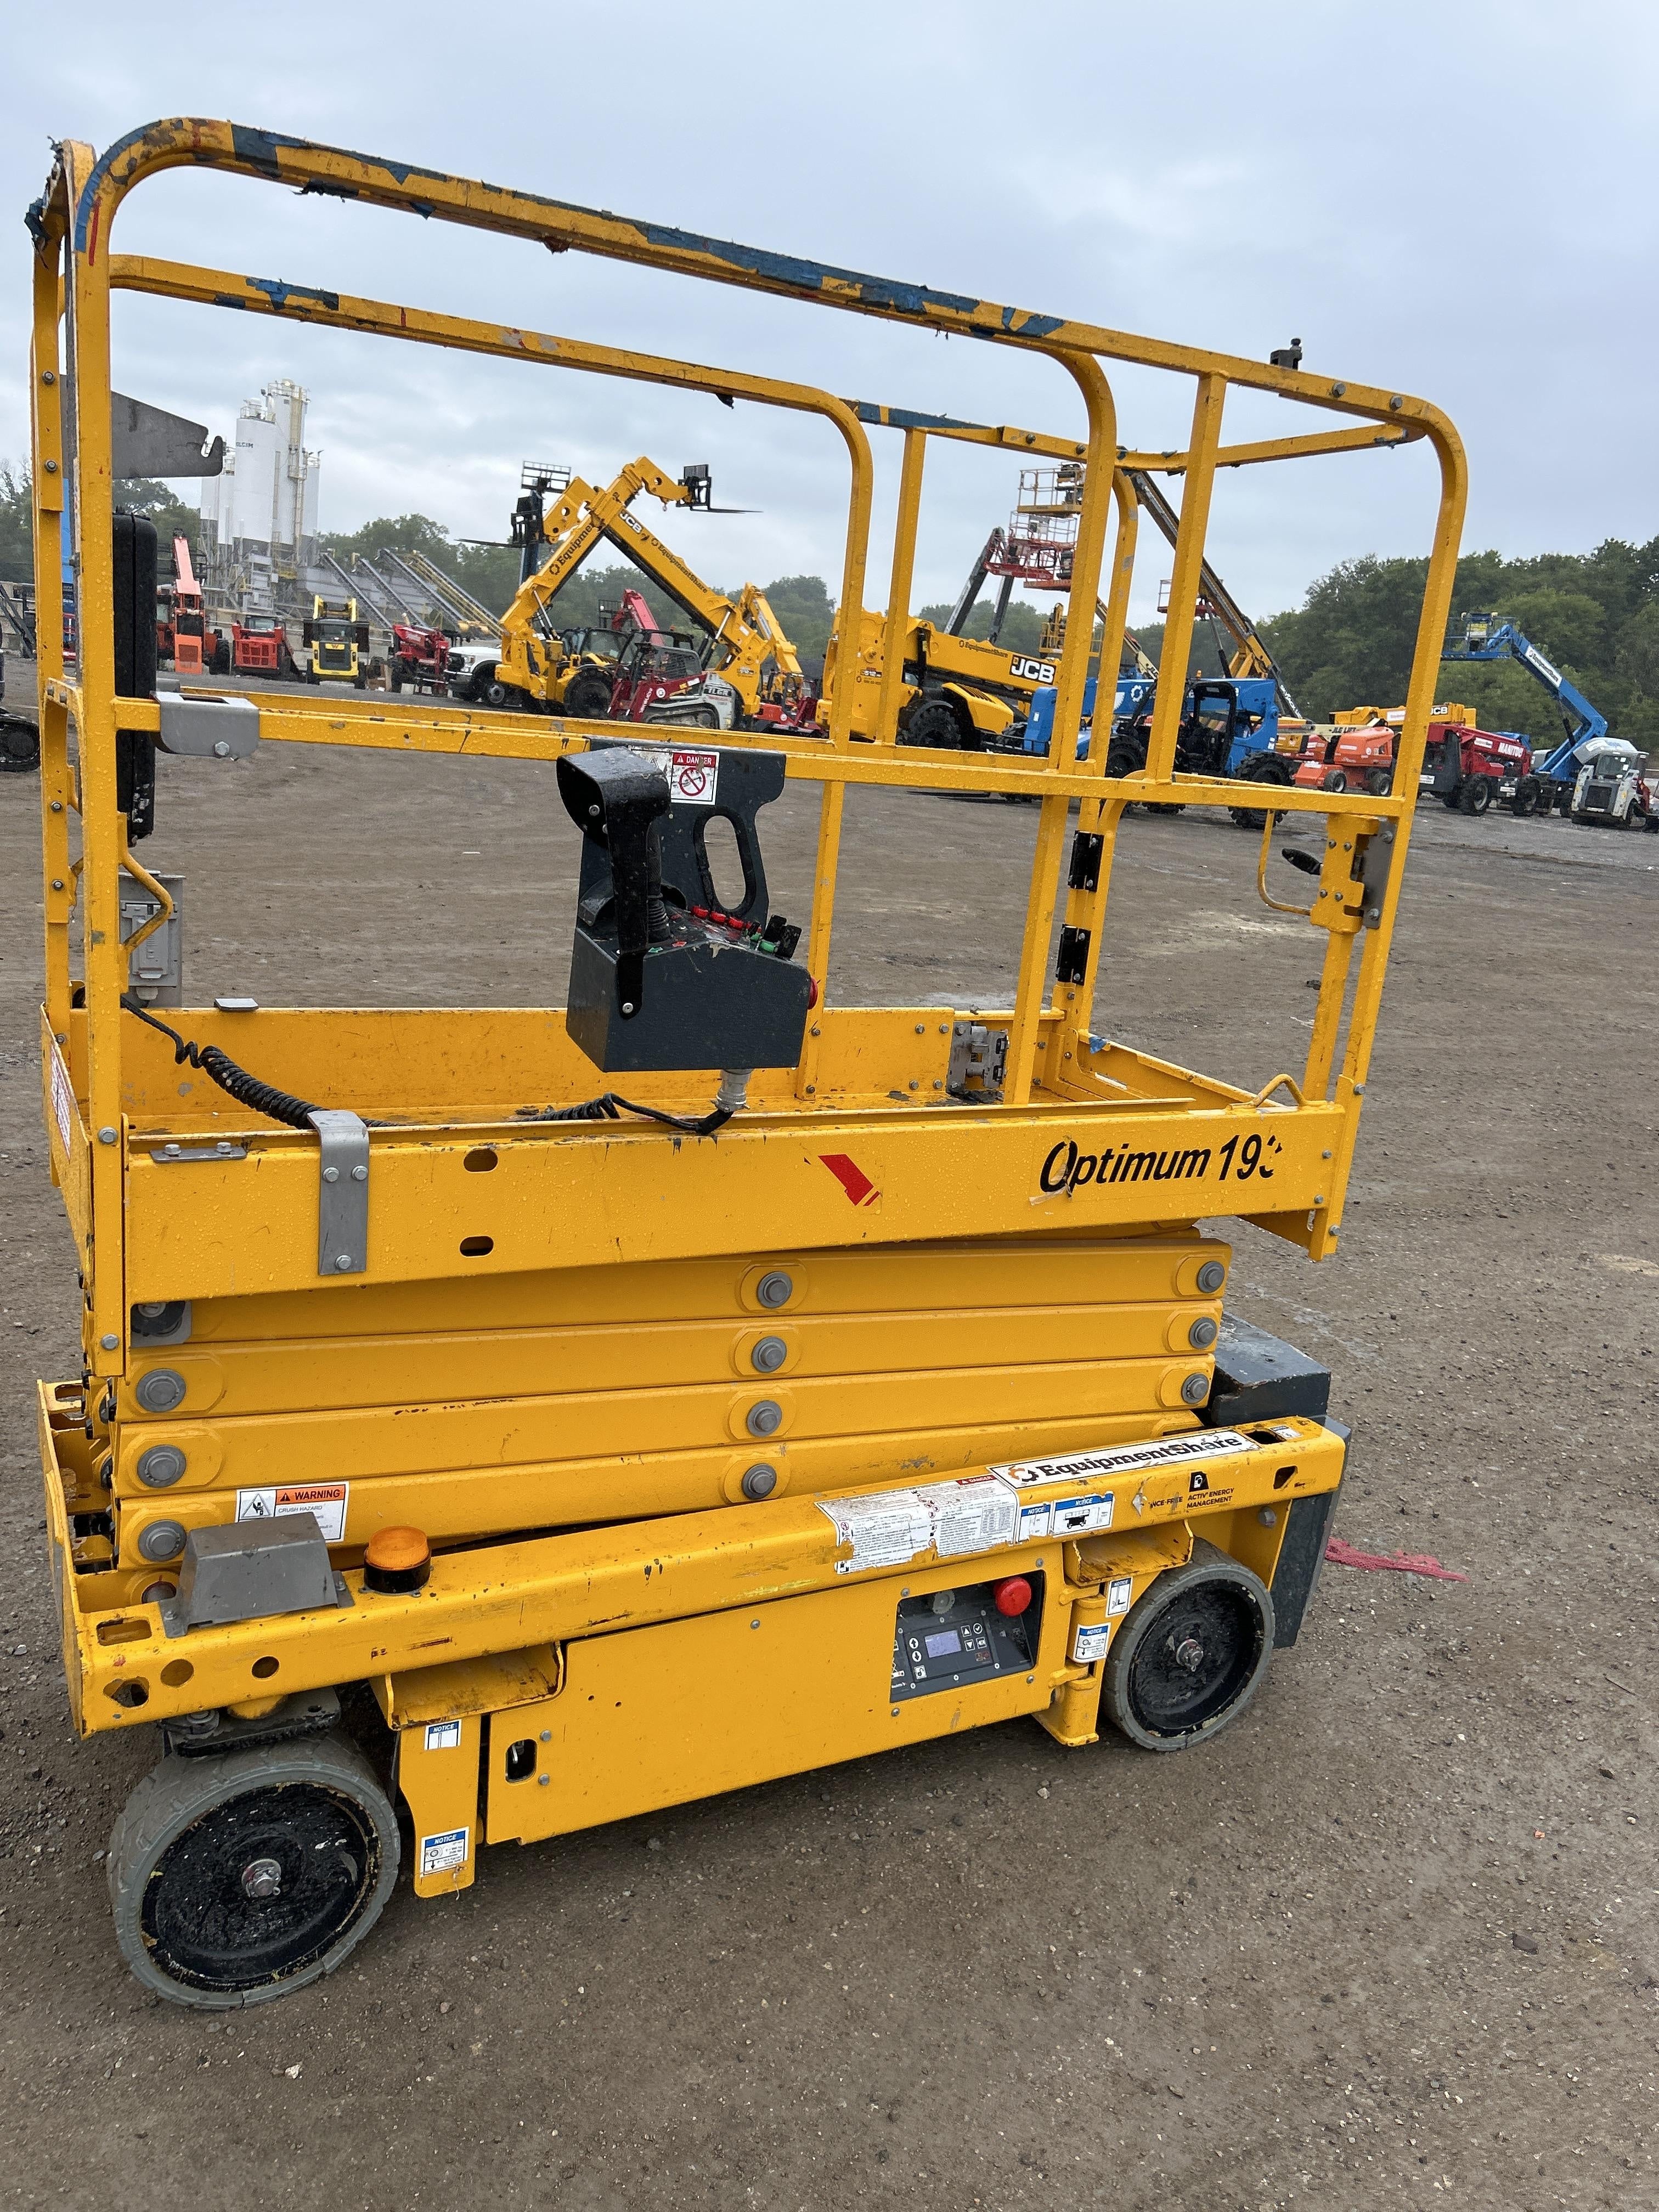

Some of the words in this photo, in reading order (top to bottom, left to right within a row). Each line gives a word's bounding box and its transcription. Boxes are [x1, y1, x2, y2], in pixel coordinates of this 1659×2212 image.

[618, 511, 643, 534] JCB
[658, 545, 708, 594] EquipmentShare
[965, 641, 1008, 658] EquipmentShare
[1012, 659, 1055, 684] JCB
[686, 756, 712, 765] DANER
[1040, 1139, 1211, 1198] Optimum
[1035, 1436, 1243, 1476] EquipmentShare
[294, 1489, 341, 1500] WARNING
[1209, 1488, 1234, 1497] ENERGY
[1075, 1497, 1093, 1506] NOTICE
[1186, 1496, 1233, 1509] MANAGEMENT
[433, 1723, 455, 1733] NOTICE
[435, 1834, 457, 1844] NOTICE
